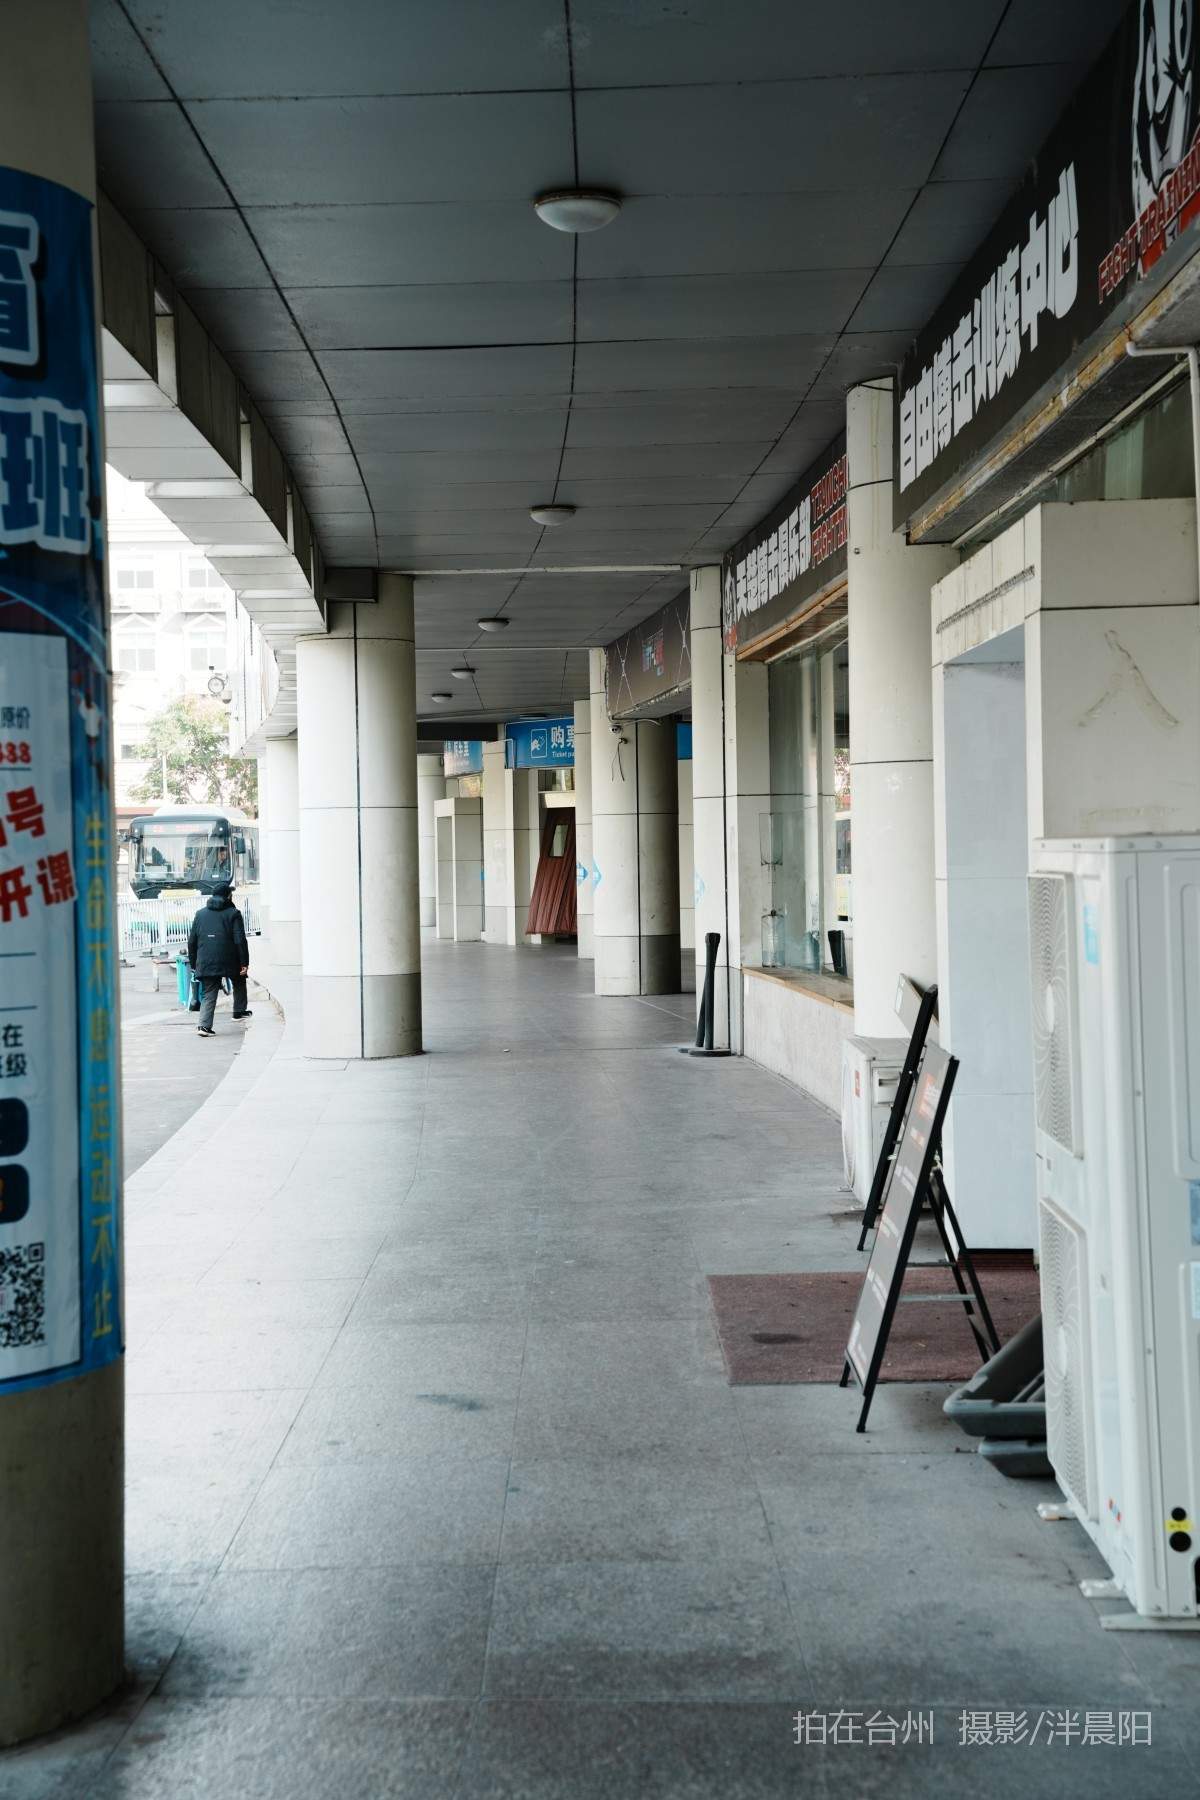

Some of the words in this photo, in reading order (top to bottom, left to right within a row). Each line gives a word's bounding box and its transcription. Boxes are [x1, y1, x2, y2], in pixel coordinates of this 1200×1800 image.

[899, 161, 1079, 493] 自由搏击训练中心
[0, 740, 31, 764] 88
[0, 785, 46, 848] 号
[0, 1052, 27, 1078] 级
